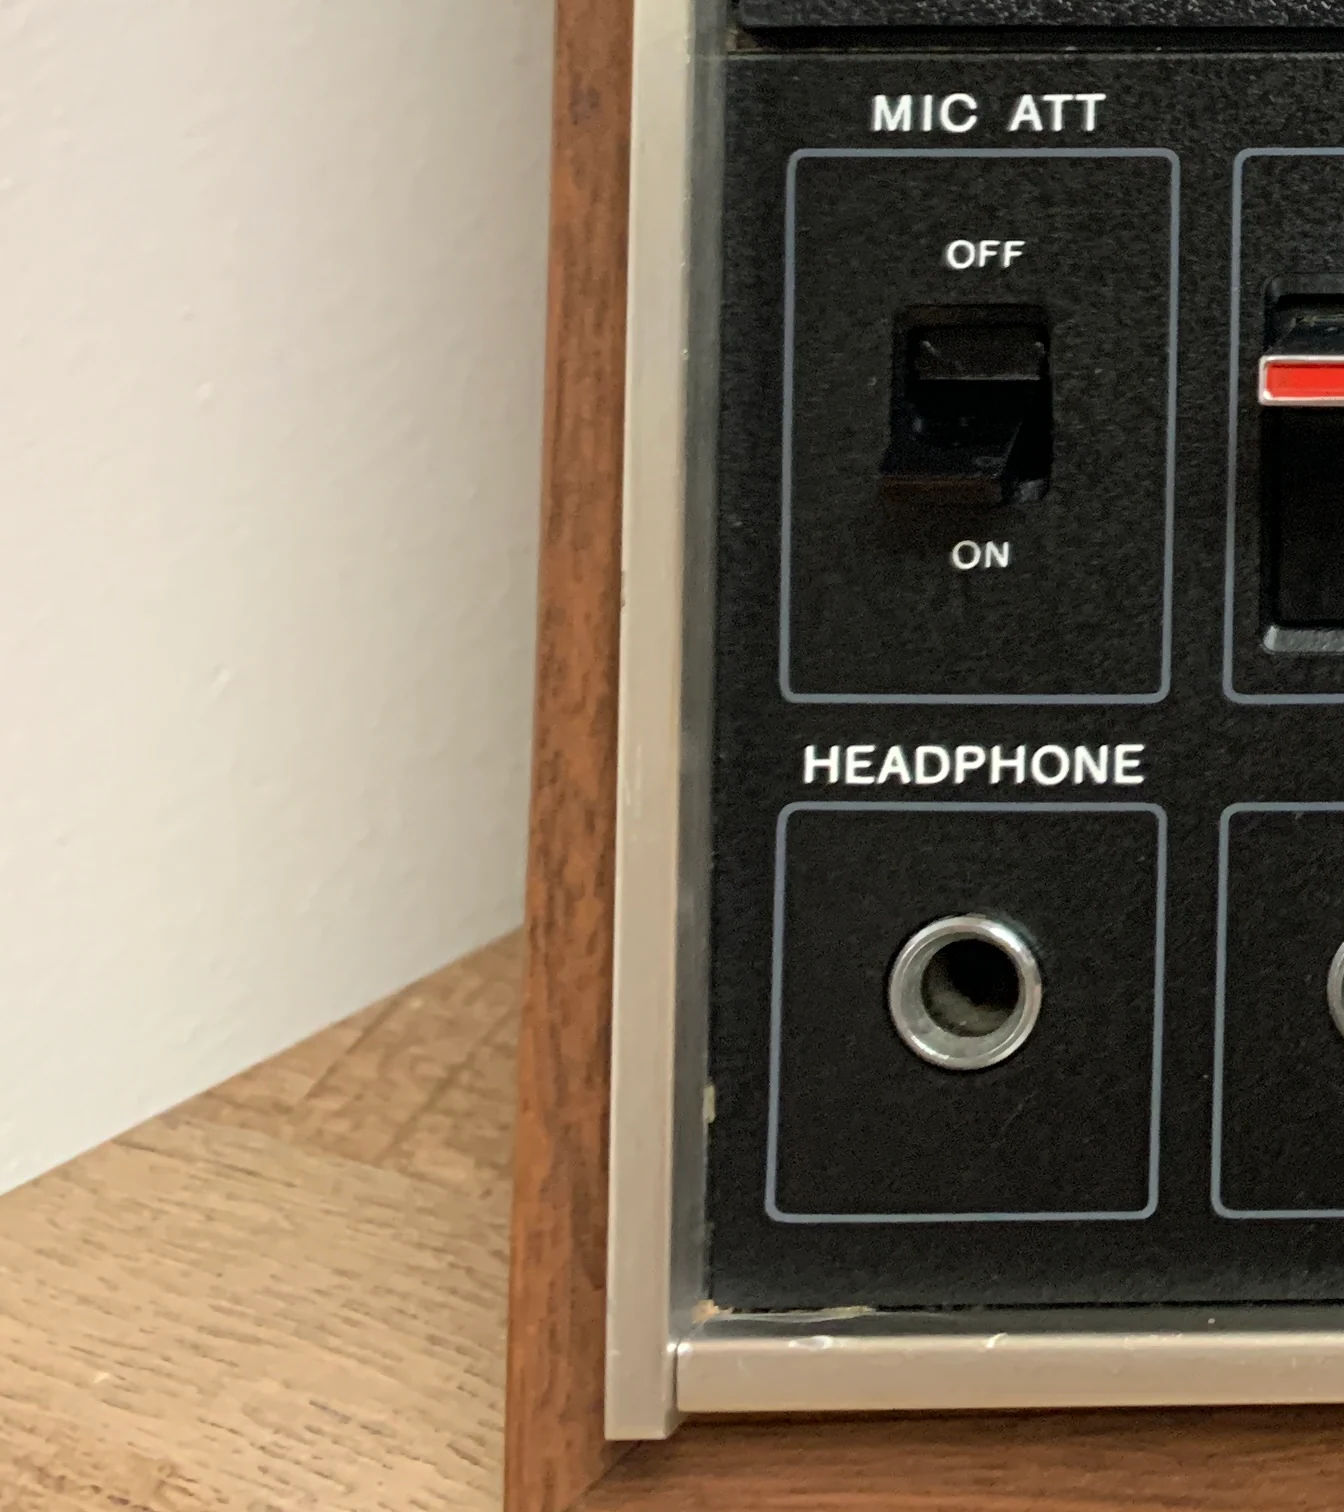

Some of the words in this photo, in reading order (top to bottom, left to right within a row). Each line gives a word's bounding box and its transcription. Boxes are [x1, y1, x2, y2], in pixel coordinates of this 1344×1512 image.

[872, 93, 978, 133] MIC
[1008, 93, 1107, 132] ATT
[945, 239, 1026, 270] OFF
[951, 540, 1011, 570] ON
[803, 743, 1145, 786] HEADPHONE
